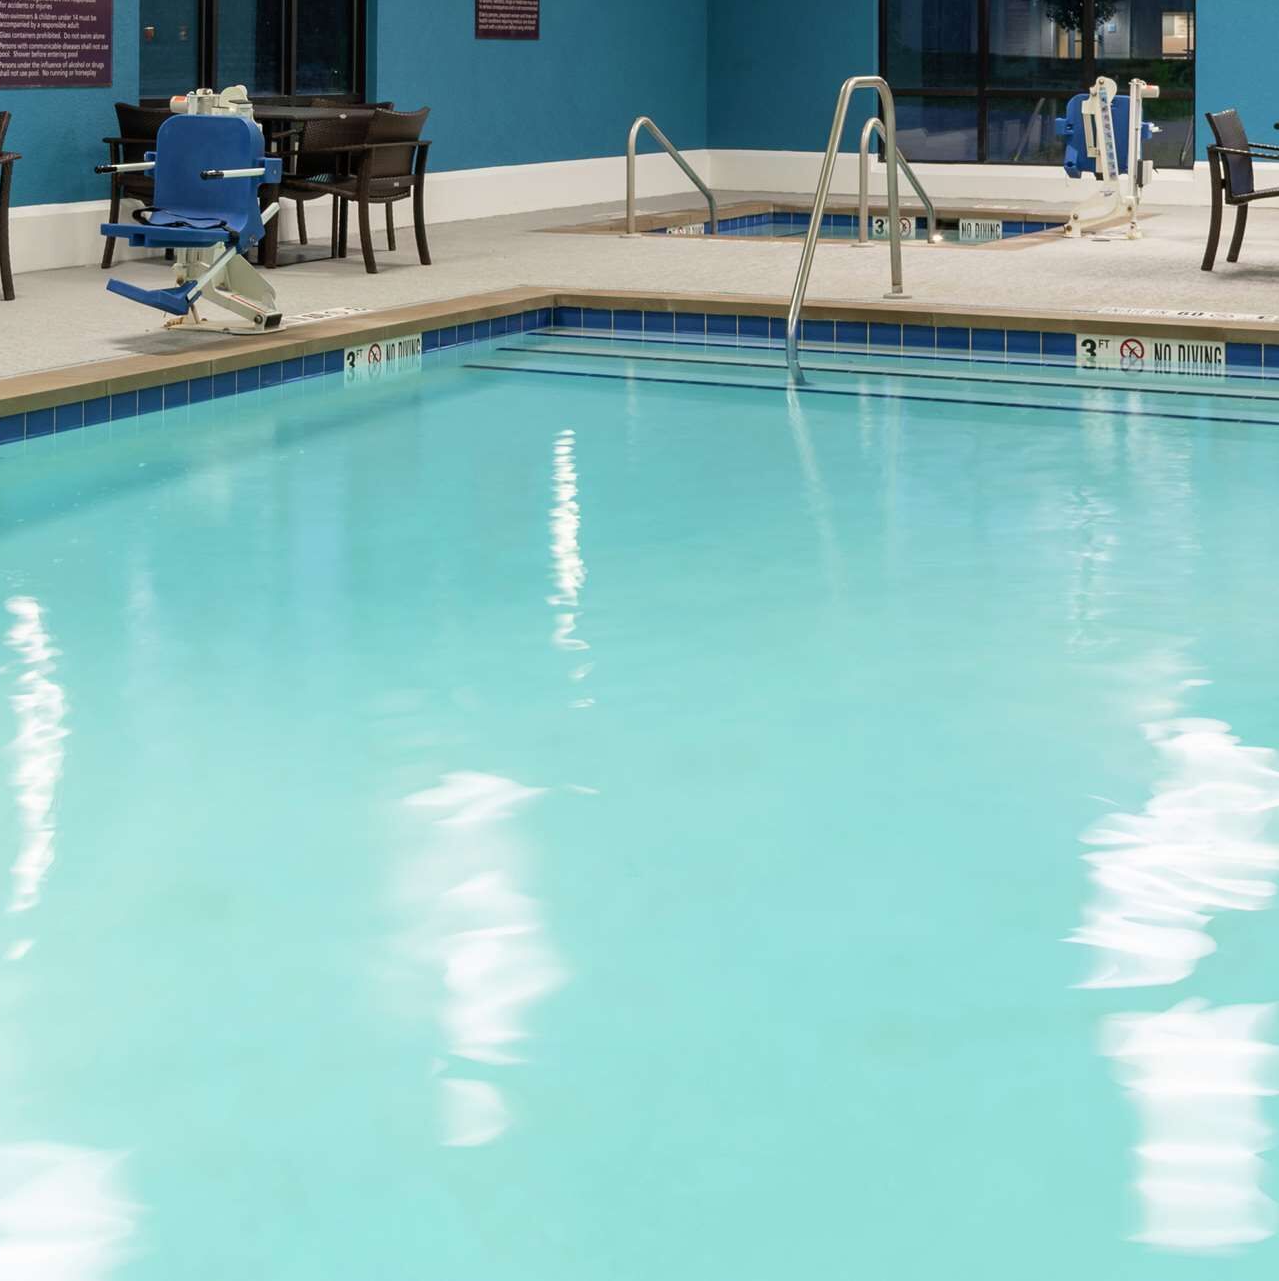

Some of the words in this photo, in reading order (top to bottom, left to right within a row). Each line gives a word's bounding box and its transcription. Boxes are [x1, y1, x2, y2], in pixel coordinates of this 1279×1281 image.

[962, 223, 971, 238] NO
[386, 343, 395, 361] NO
[398, 338, 420, 359] DIVING
[1081, 338, 1096, 357] 3
[1098, 339, 1110, 348] FT
[1154, 343, 1171, 362] NO
[1178, 345, 1222, 364] DIVING
